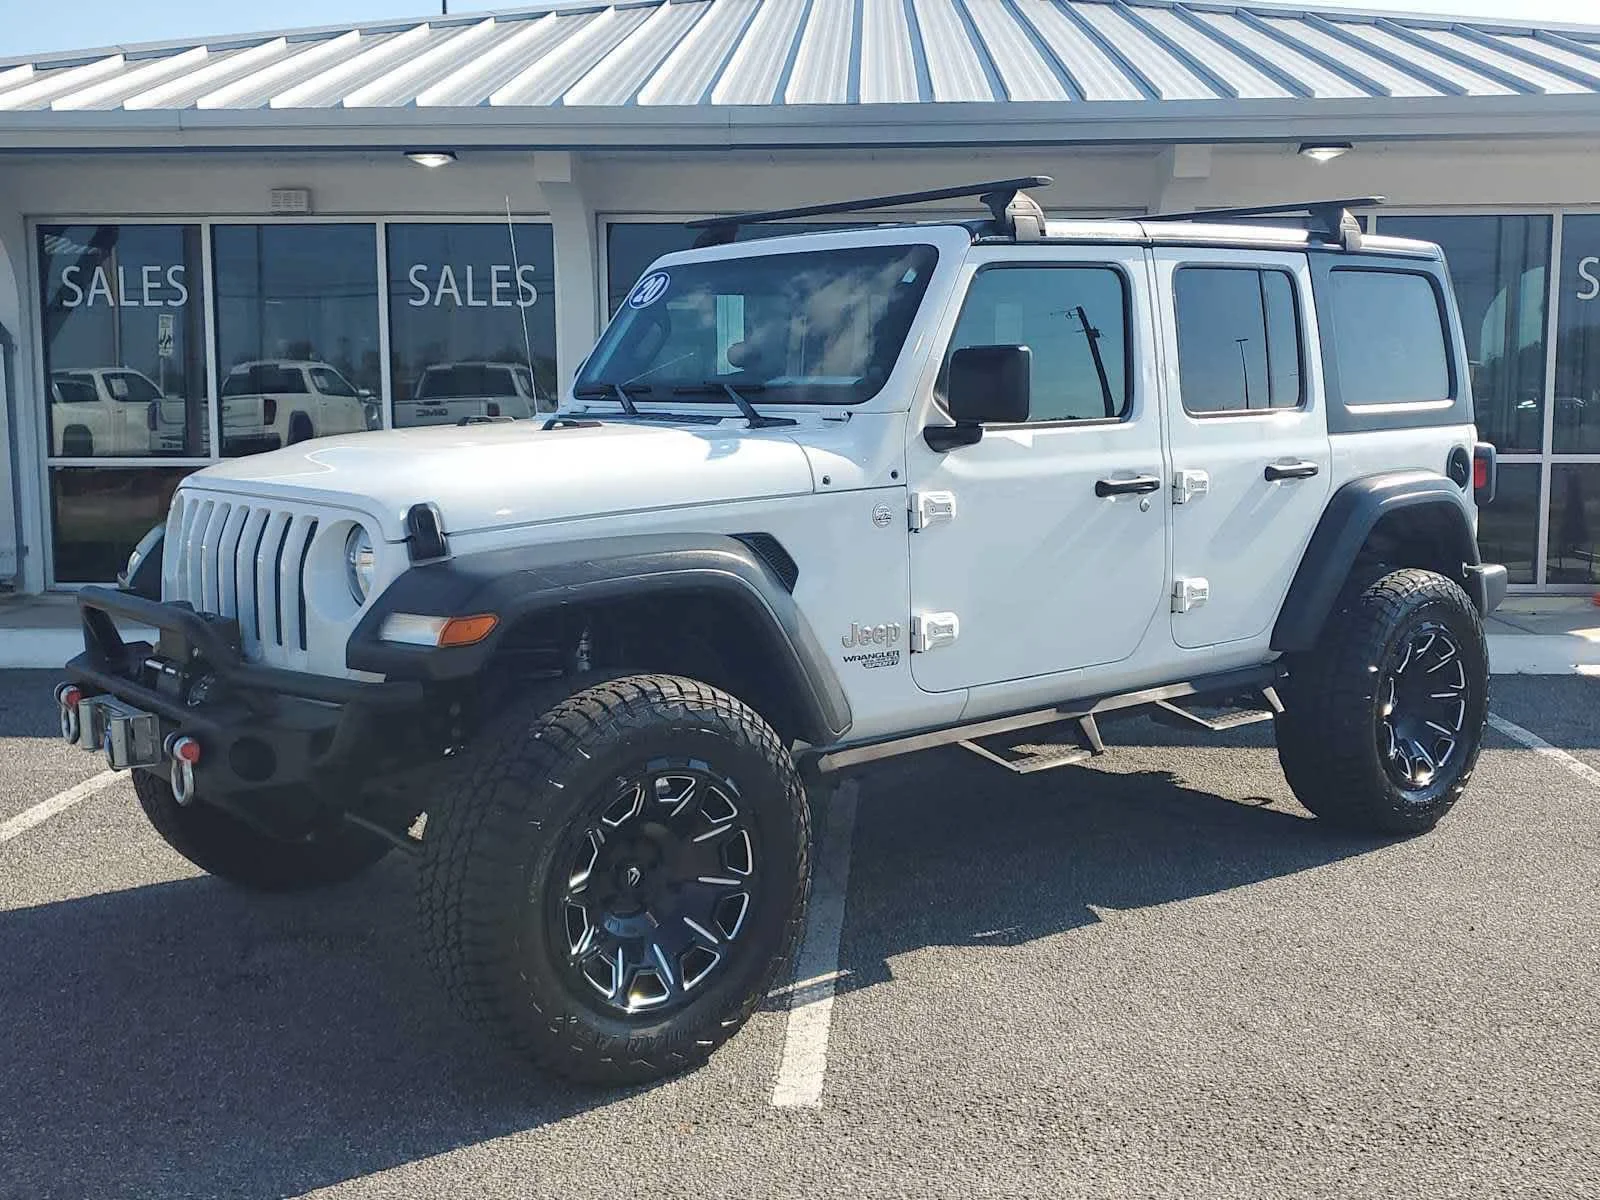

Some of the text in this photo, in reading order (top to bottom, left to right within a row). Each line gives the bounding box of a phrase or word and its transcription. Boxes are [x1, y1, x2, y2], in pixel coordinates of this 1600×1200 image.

[61, 264, 189, 307] SALES
[408, 264, 538, 307] SALES
[632, 276, 666, 303] 20
[841, 622, 901, 648] Jeep
[843, 650, 900, 663] WRANGLER
